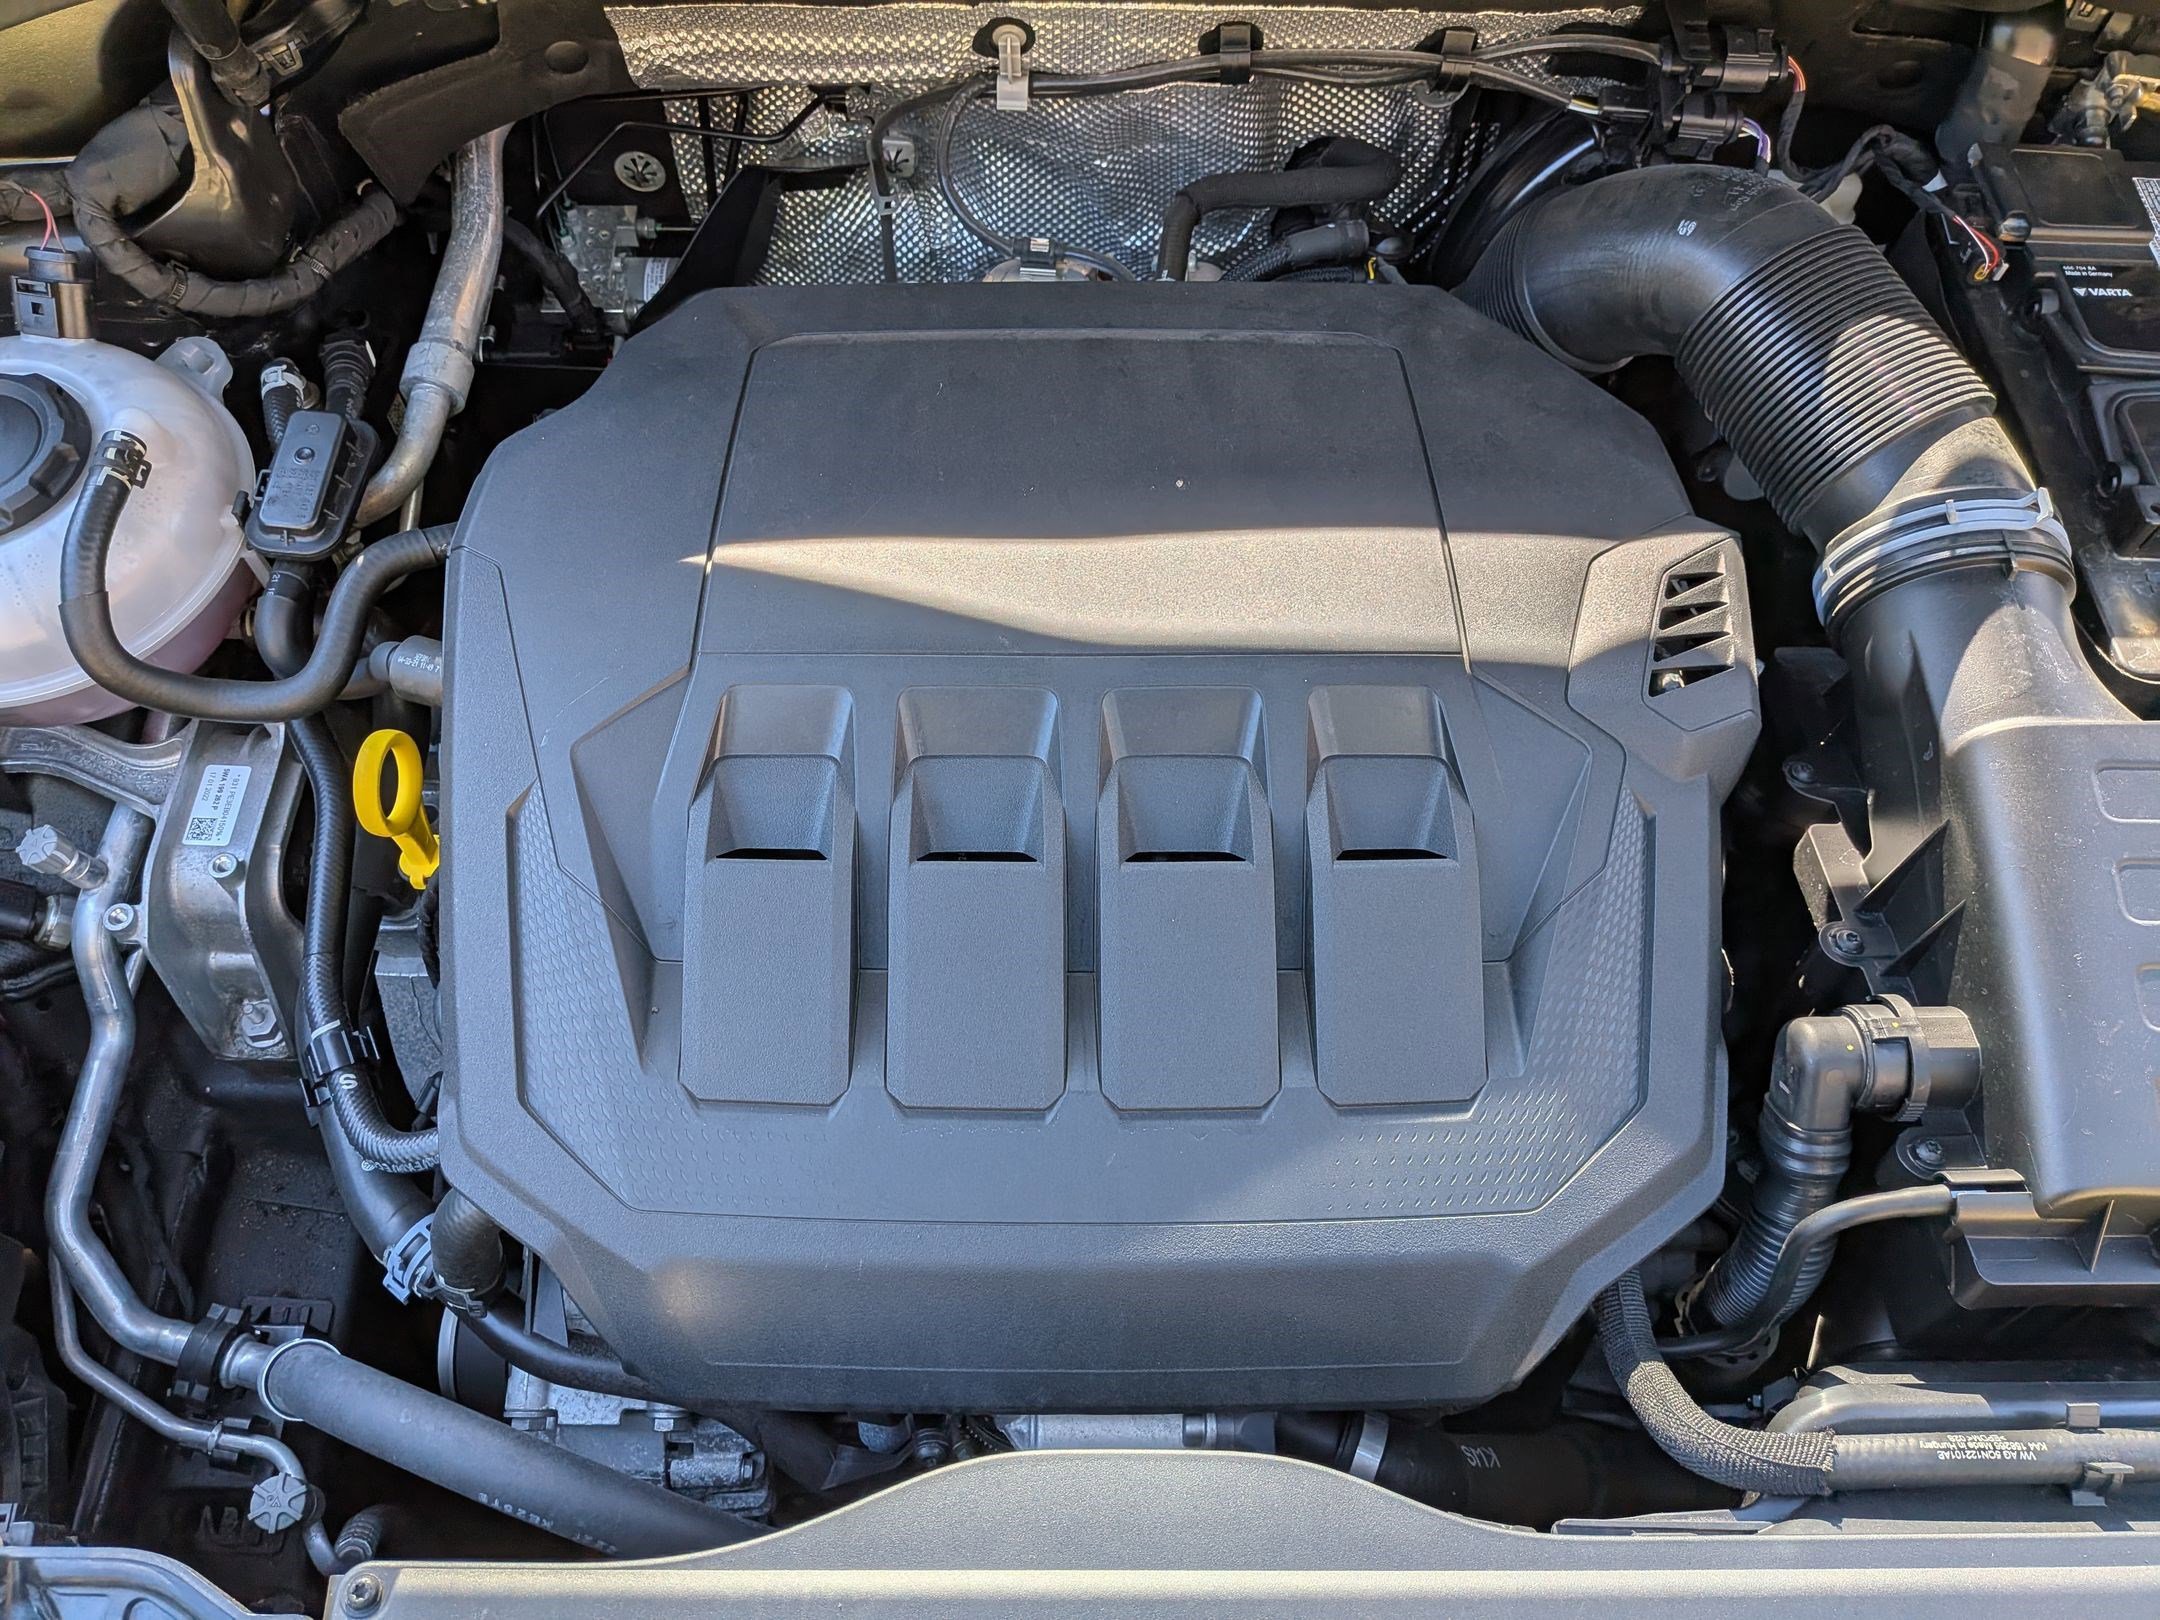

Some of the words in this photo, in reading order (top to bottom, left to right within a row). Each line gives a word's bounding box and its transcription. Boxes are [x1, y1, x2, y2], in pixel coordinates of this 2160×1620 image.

[2088, 287, 2134, 297] VARTA
[339, 1073, 358, 1089] S
[1918, 1440, 1956, 1449] Hungary
[1968, 1441, 1993, 1450] Made
[2003, 1451, 2017, 1460] AG
[2019, 1451, 2037, 1460] VW
